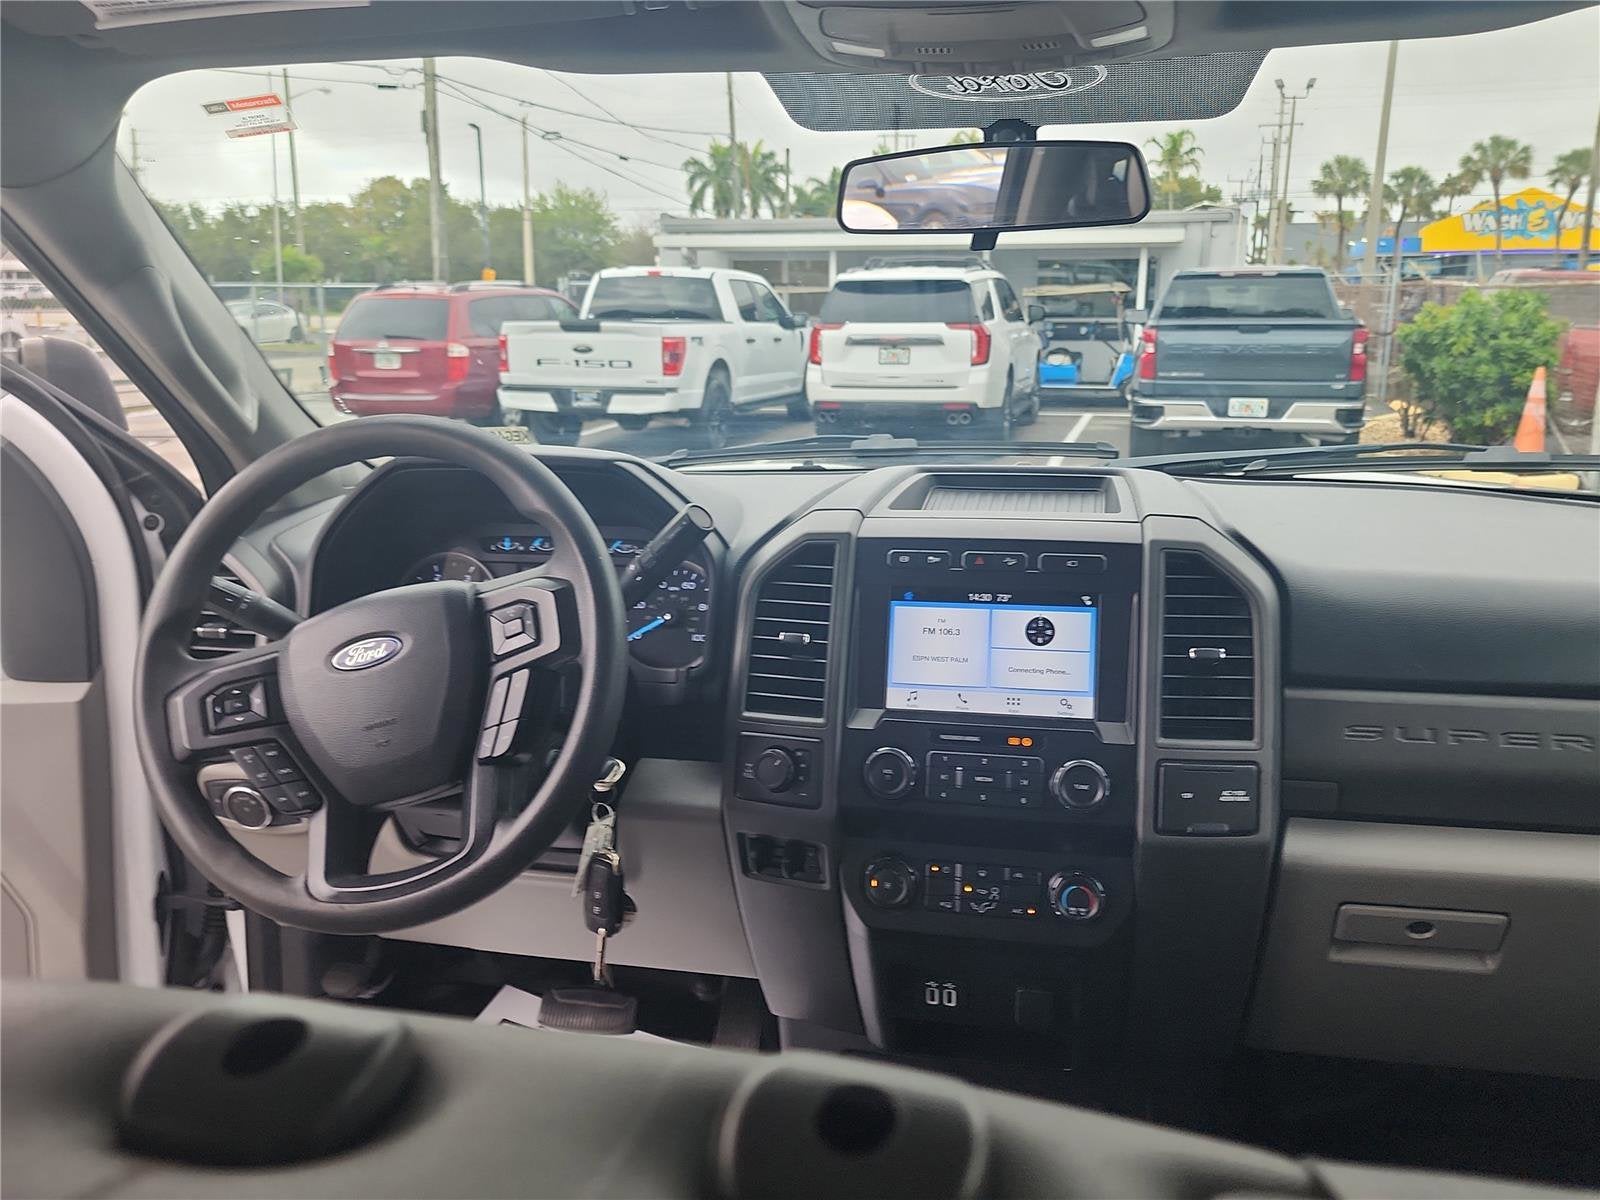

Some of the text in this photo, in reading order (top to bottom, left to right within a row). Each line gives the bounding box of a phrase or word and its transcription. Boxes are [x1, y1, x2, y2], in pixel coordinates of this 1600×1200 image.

[231, 97, 276, 108] Motorcraft
[536, 358, 633, 368] F-150
[922, 627, 961, 636] FM 106.3
[345, 642, 388, 666] Ford
[1008, 666, 1044, 675] Connecting
[1344, 725, 1595, 752] SUPER
